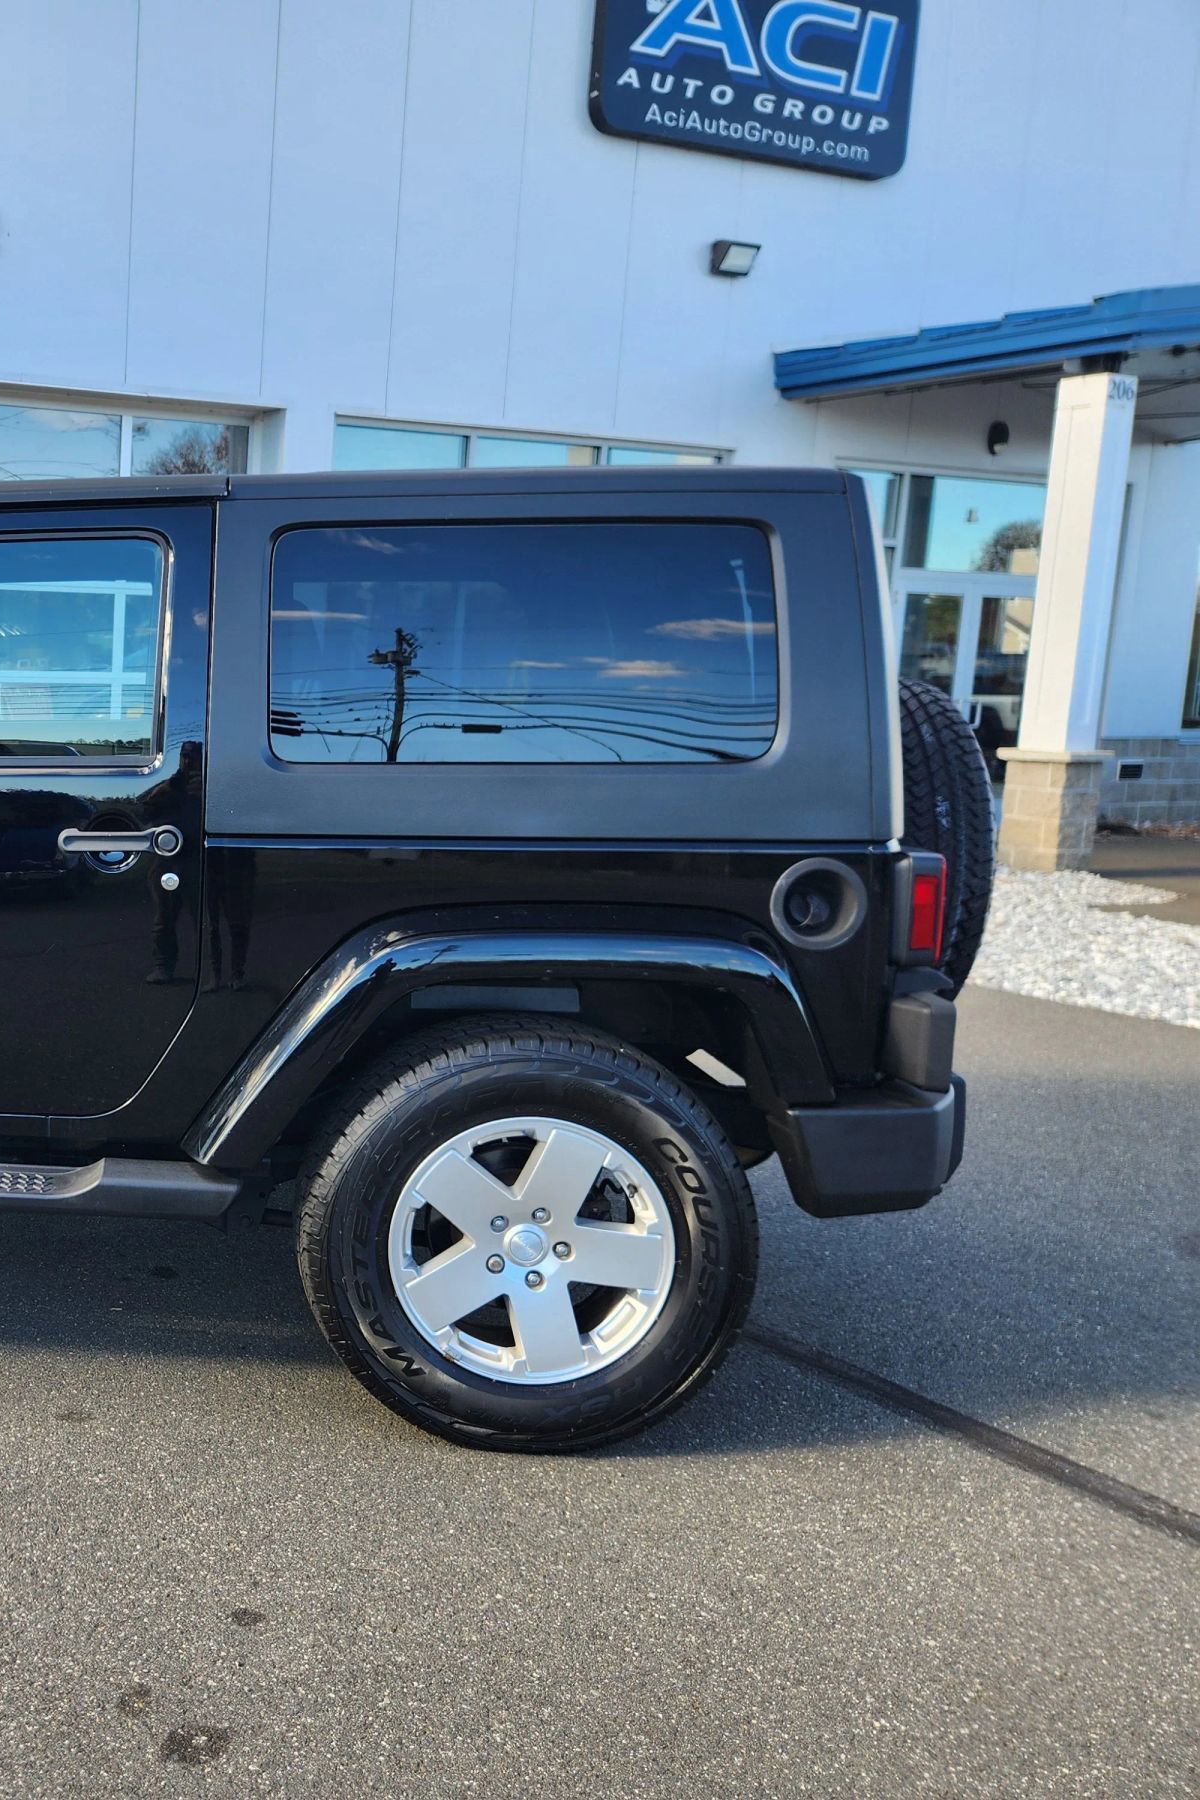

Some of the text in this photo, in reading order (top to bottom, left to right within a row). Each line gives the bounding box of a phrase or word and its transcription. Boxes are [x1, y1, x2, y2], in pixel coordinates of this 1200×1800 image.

[629, 0, 900, 102] ACI
[616, 66, 890, 135] AUTO GROUP
[644, 103, 870, 162] AciAutoGroup.com
[1108, 379, 1135, 401] 206
